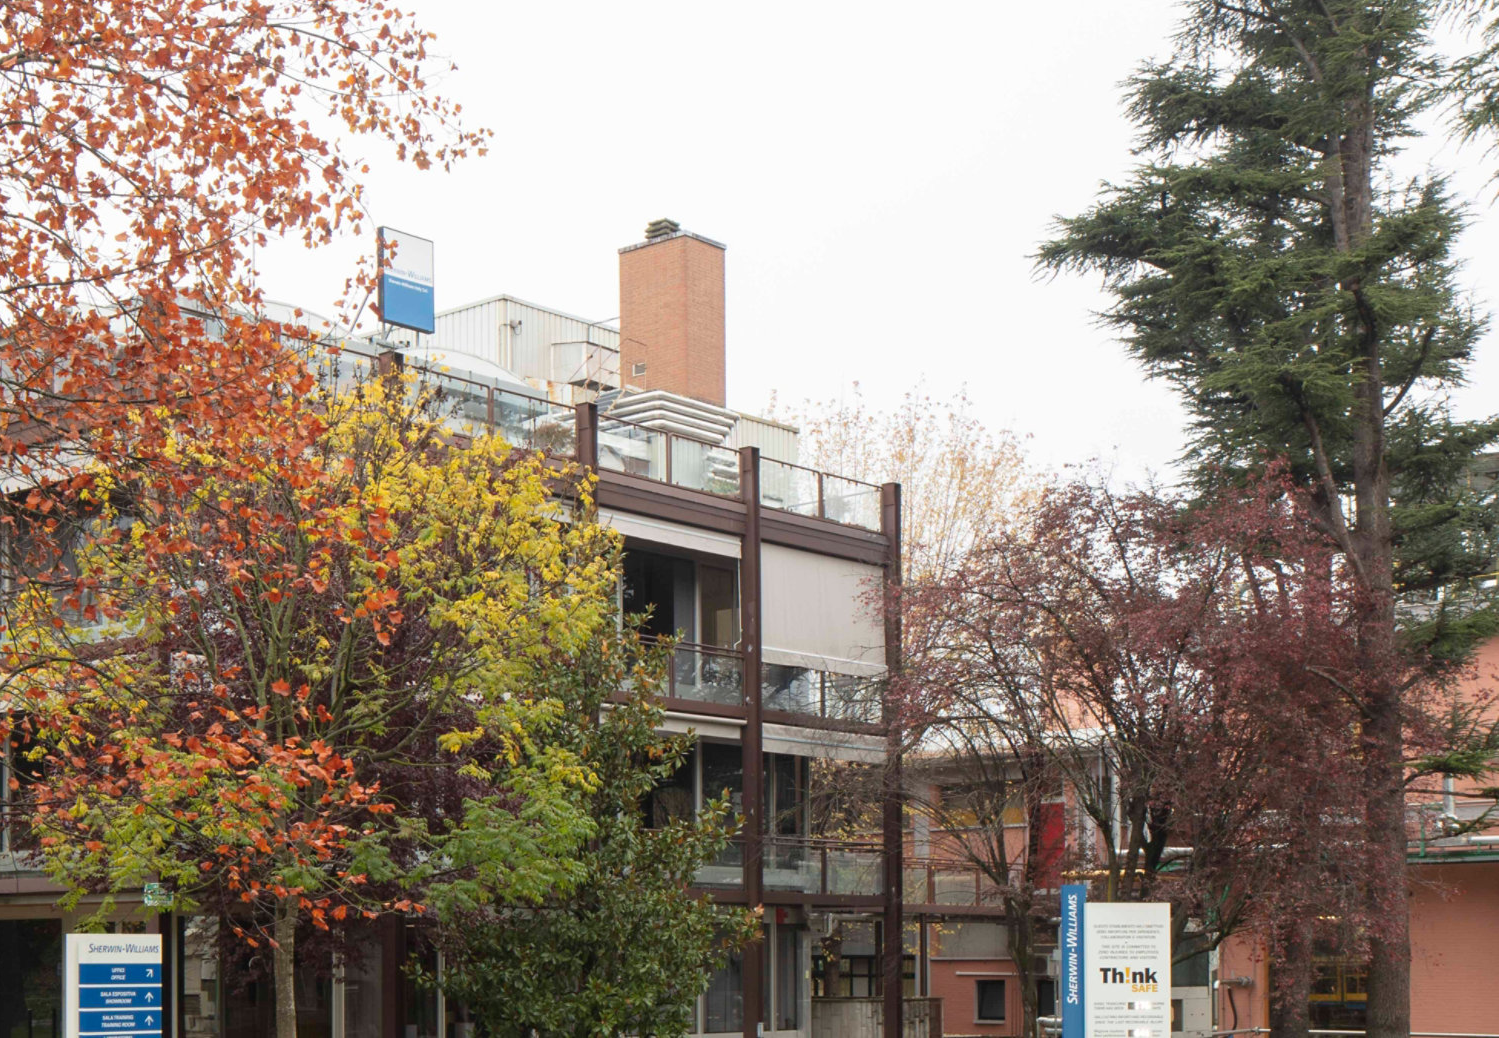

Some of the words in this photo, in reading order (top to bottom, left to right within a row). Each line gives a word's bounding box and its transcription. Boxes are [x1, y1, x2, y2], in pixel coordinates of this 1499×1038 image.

[88, 943, 159, 953] SHERWIN-WILLIAMS
[1066, 894, 1078, 1005] SHERWIN-WILLIAMS
[1099, 967, 1157, 984] Th!nk
[1131, 984, 1158, 992] SAFE
